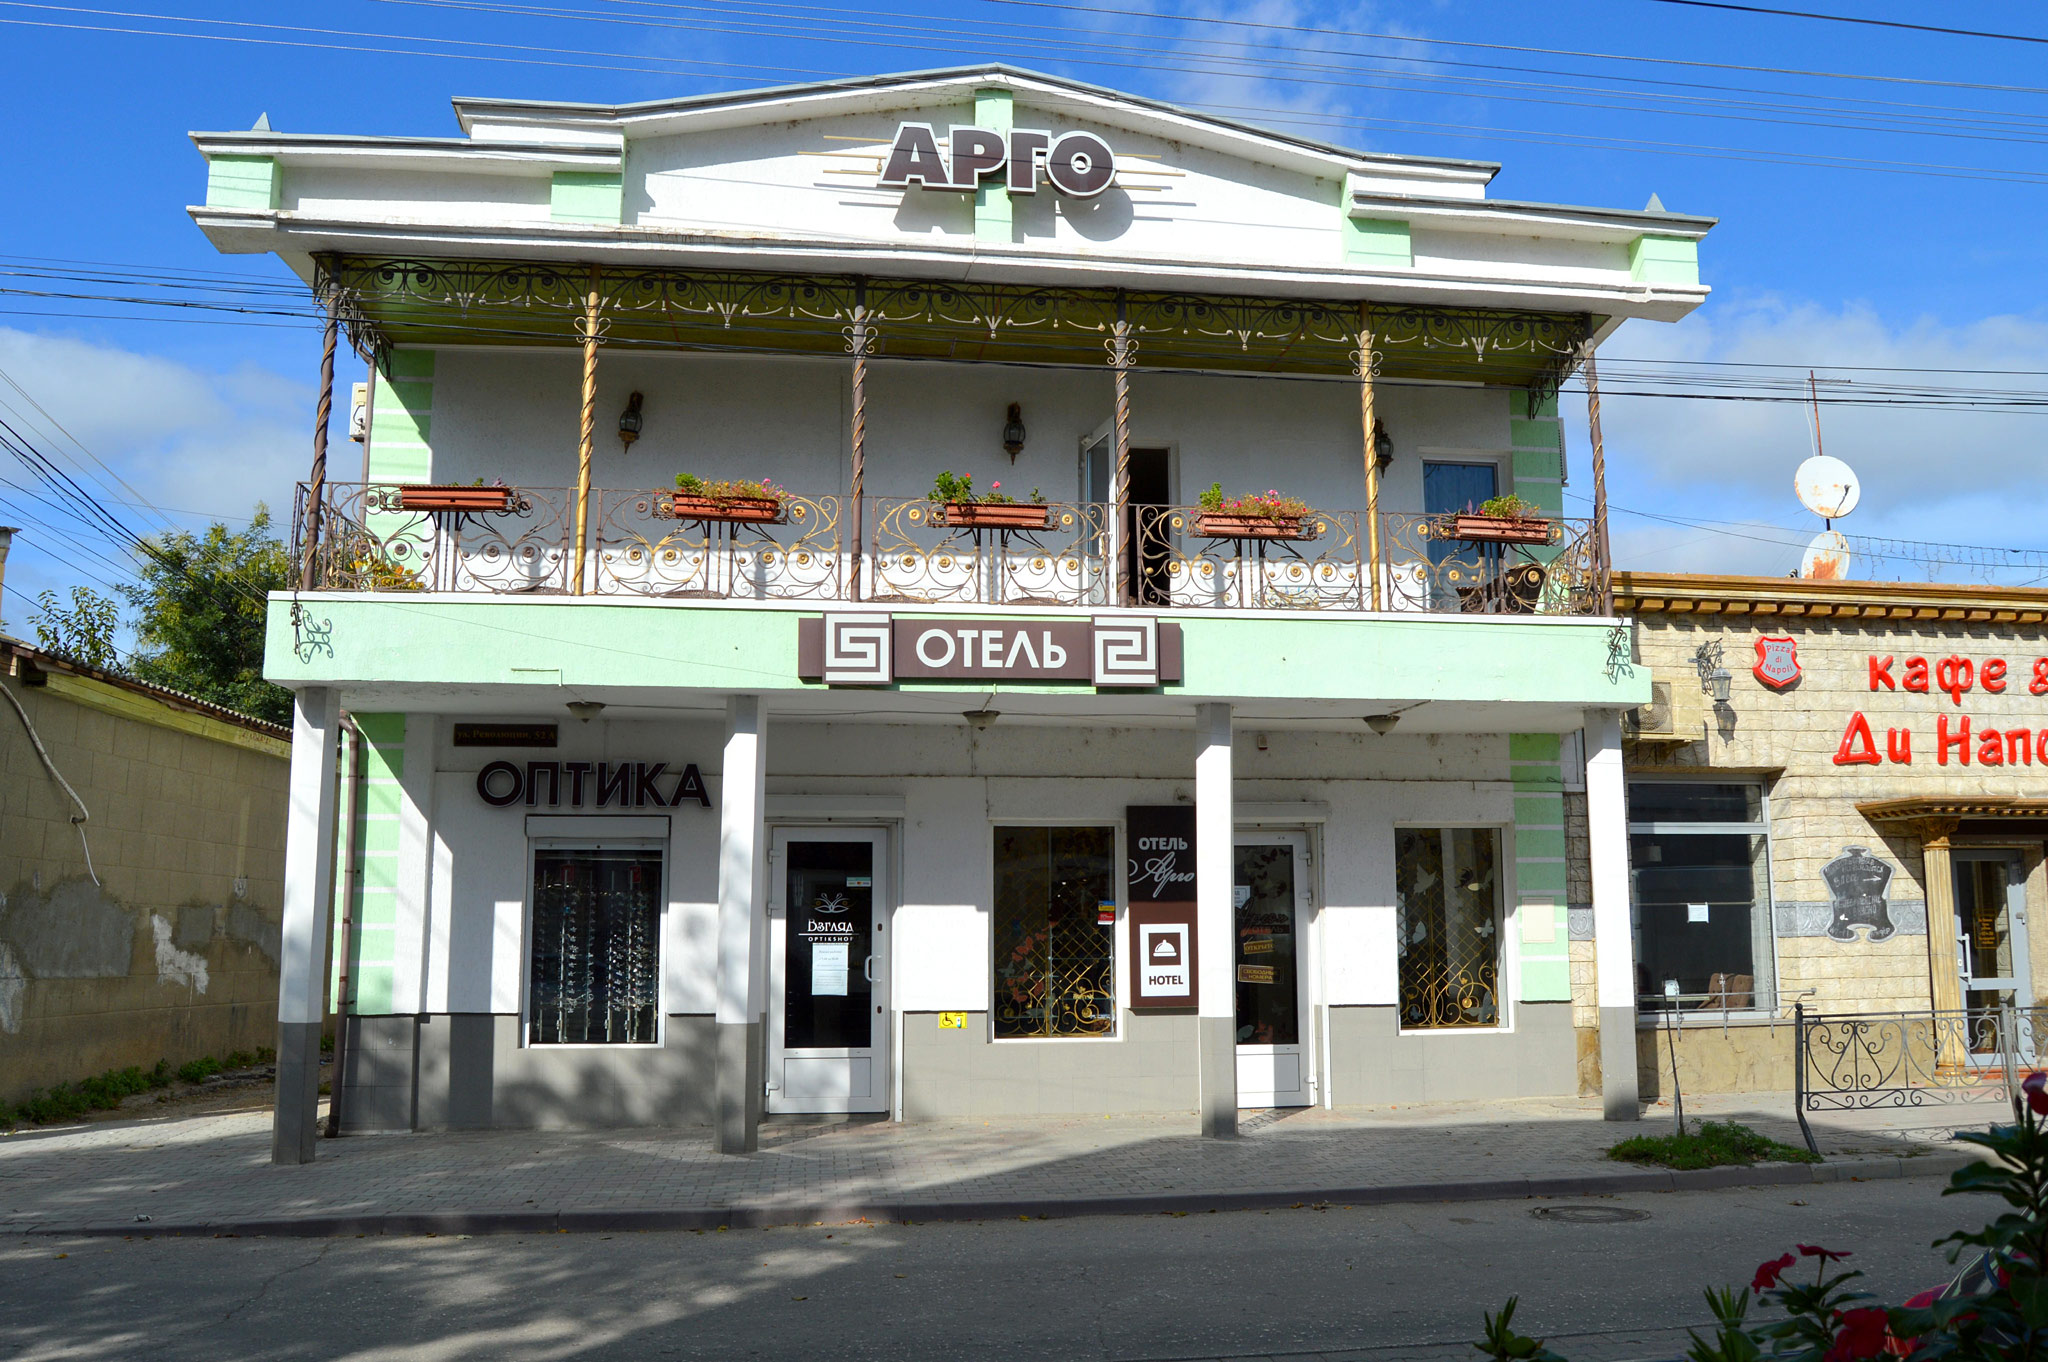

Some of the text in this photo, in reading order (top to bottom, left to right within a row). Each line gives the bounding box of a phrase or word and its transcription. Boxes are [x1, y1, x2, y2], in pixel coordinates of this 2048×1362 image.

[876, 121, 1117, 199] АРГО
[916, 628, 1067, 669] ОТЕЛЬ
[1766, 644, 1791, 653] Pizza
[1775, 655, 1782, 663] di
[1765, 664, 1793, 675] Napoli
[477, 761, 712, 808] ОПТИКА
[1138, 837, 1188, 850] ОТЕЛЬ
[1149, 975, 1183, 985] HOTEL
